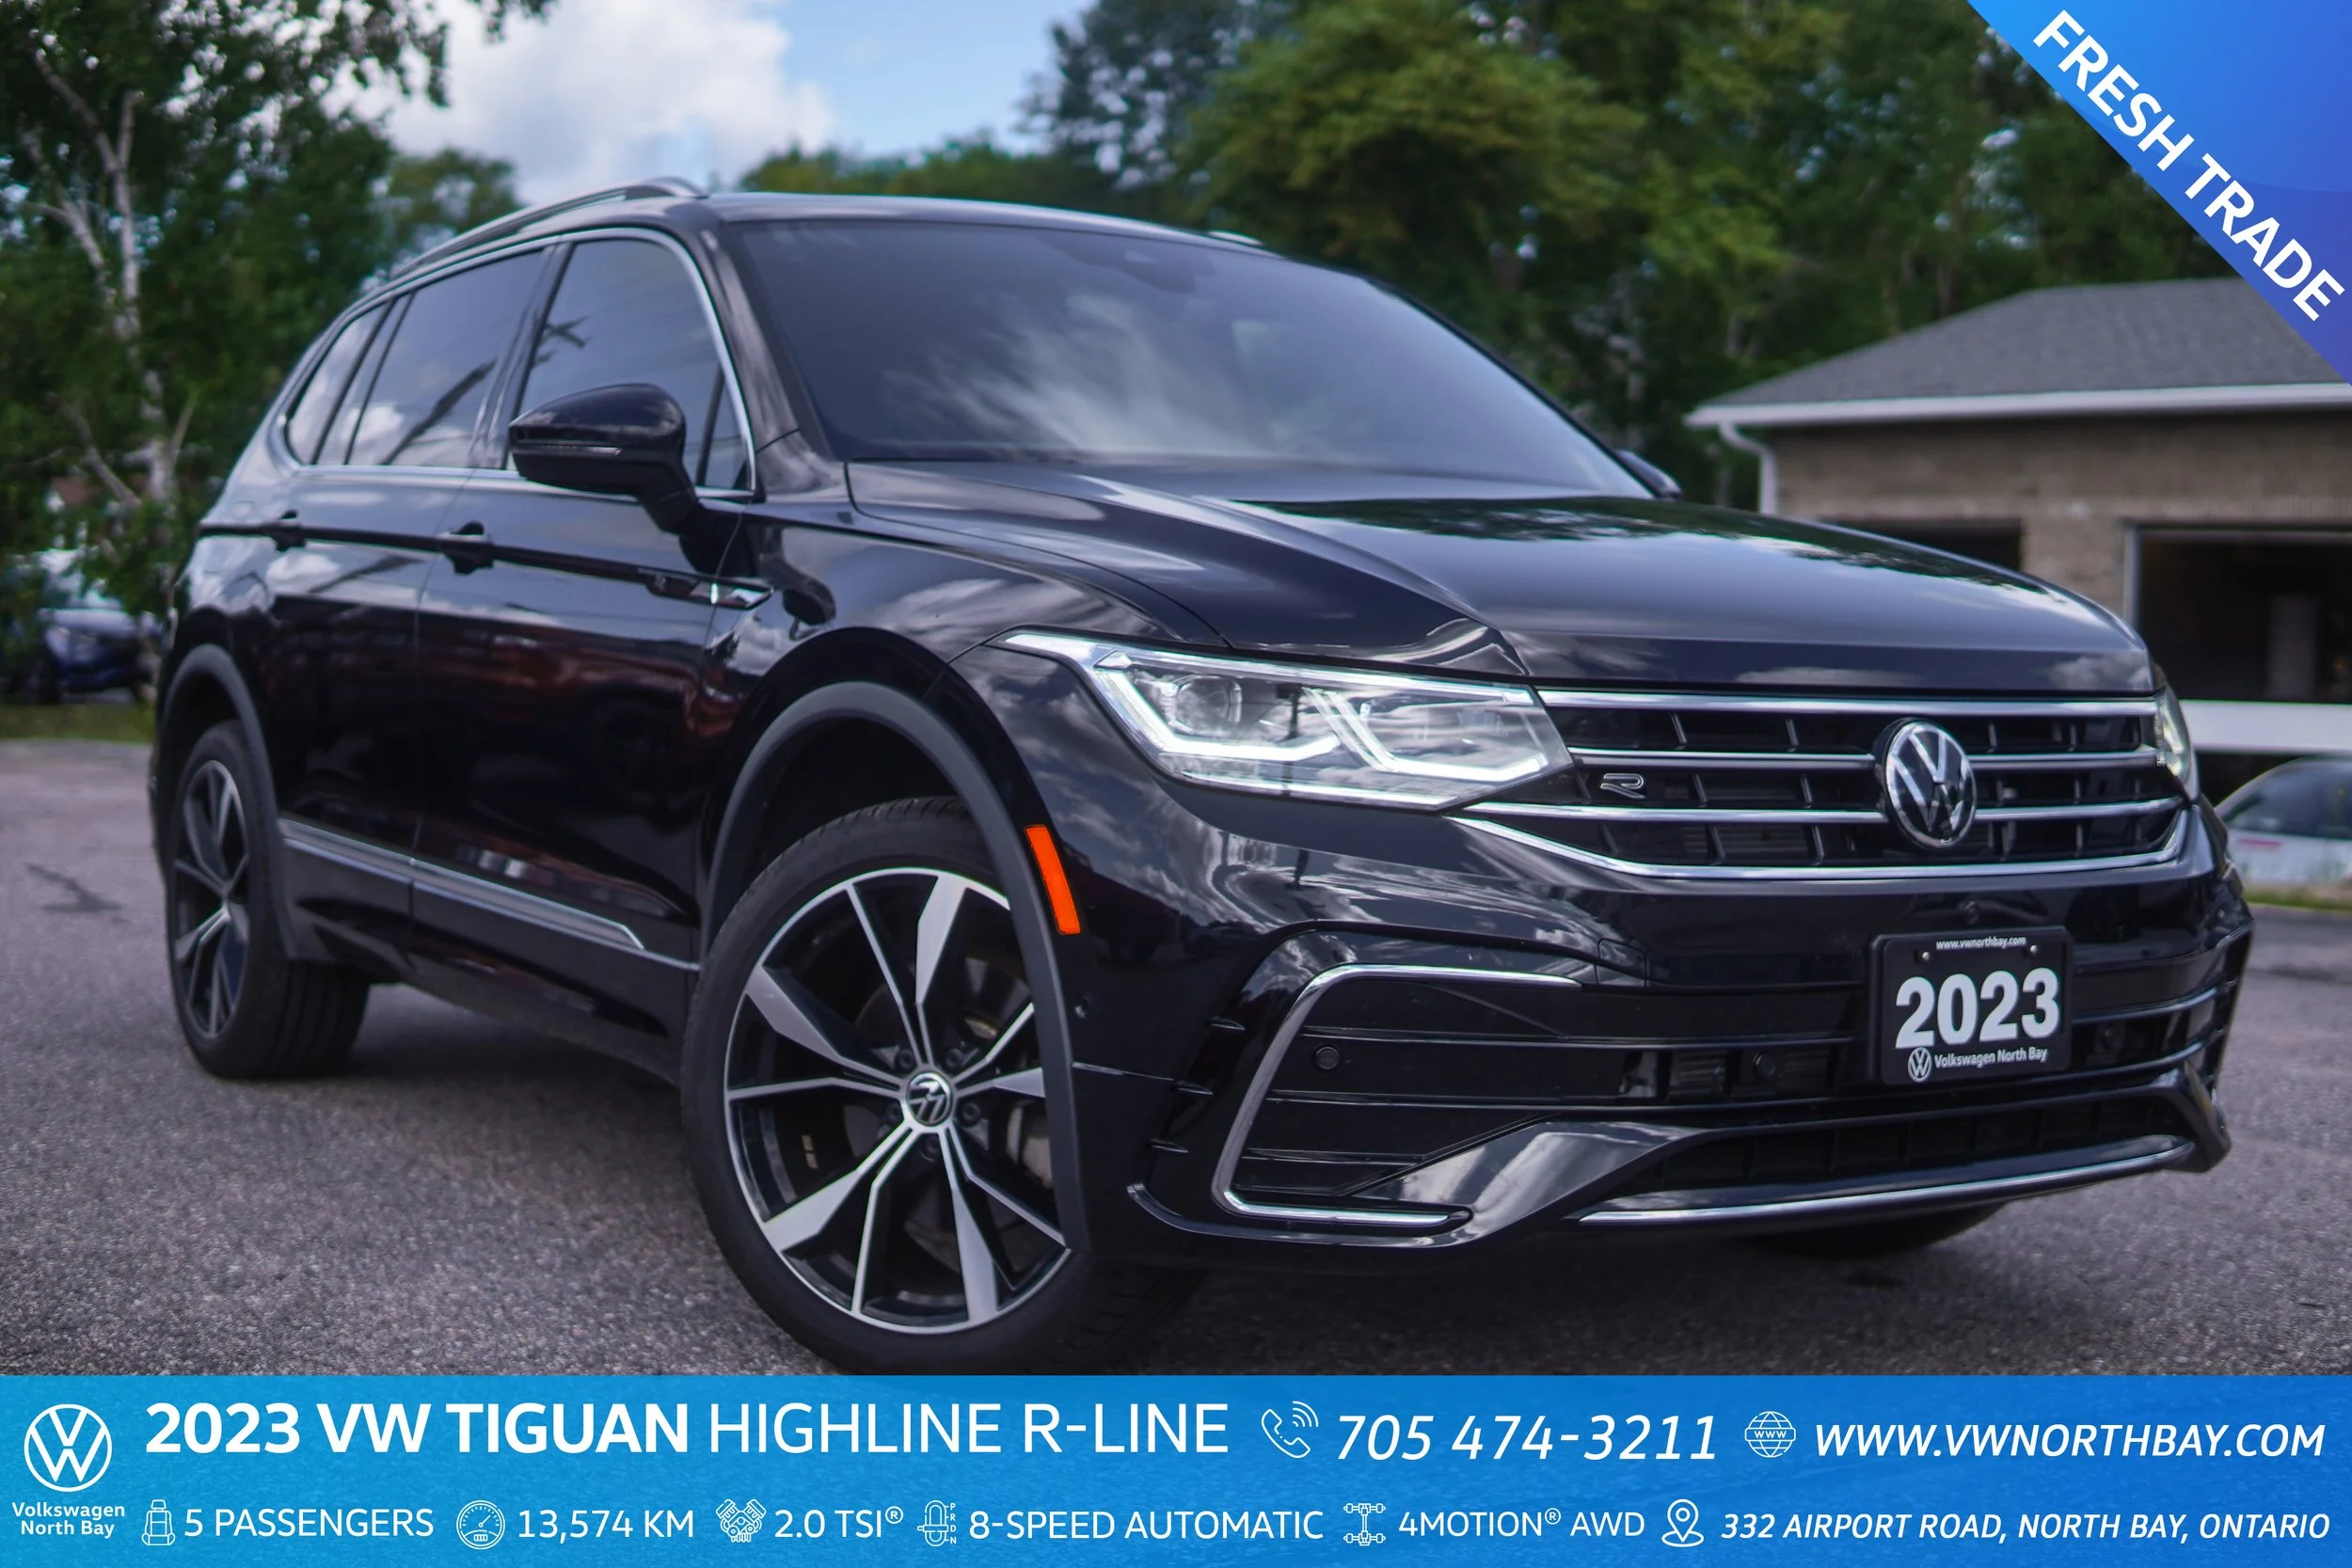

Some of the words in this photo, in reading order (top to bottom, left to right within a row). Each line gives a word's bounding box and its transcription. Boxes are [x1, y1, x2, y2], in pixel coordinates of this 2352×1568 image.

[1935, 936, 2026, 950] www.vwnorthbay.com
[1895, 967, 2059, 1049] 2023
[1934, 1053, 1996, 1069] Volkswagen
[1996, 1049, 2026, 1063] North
[2027, 1046, 2047, 1063] Bay
